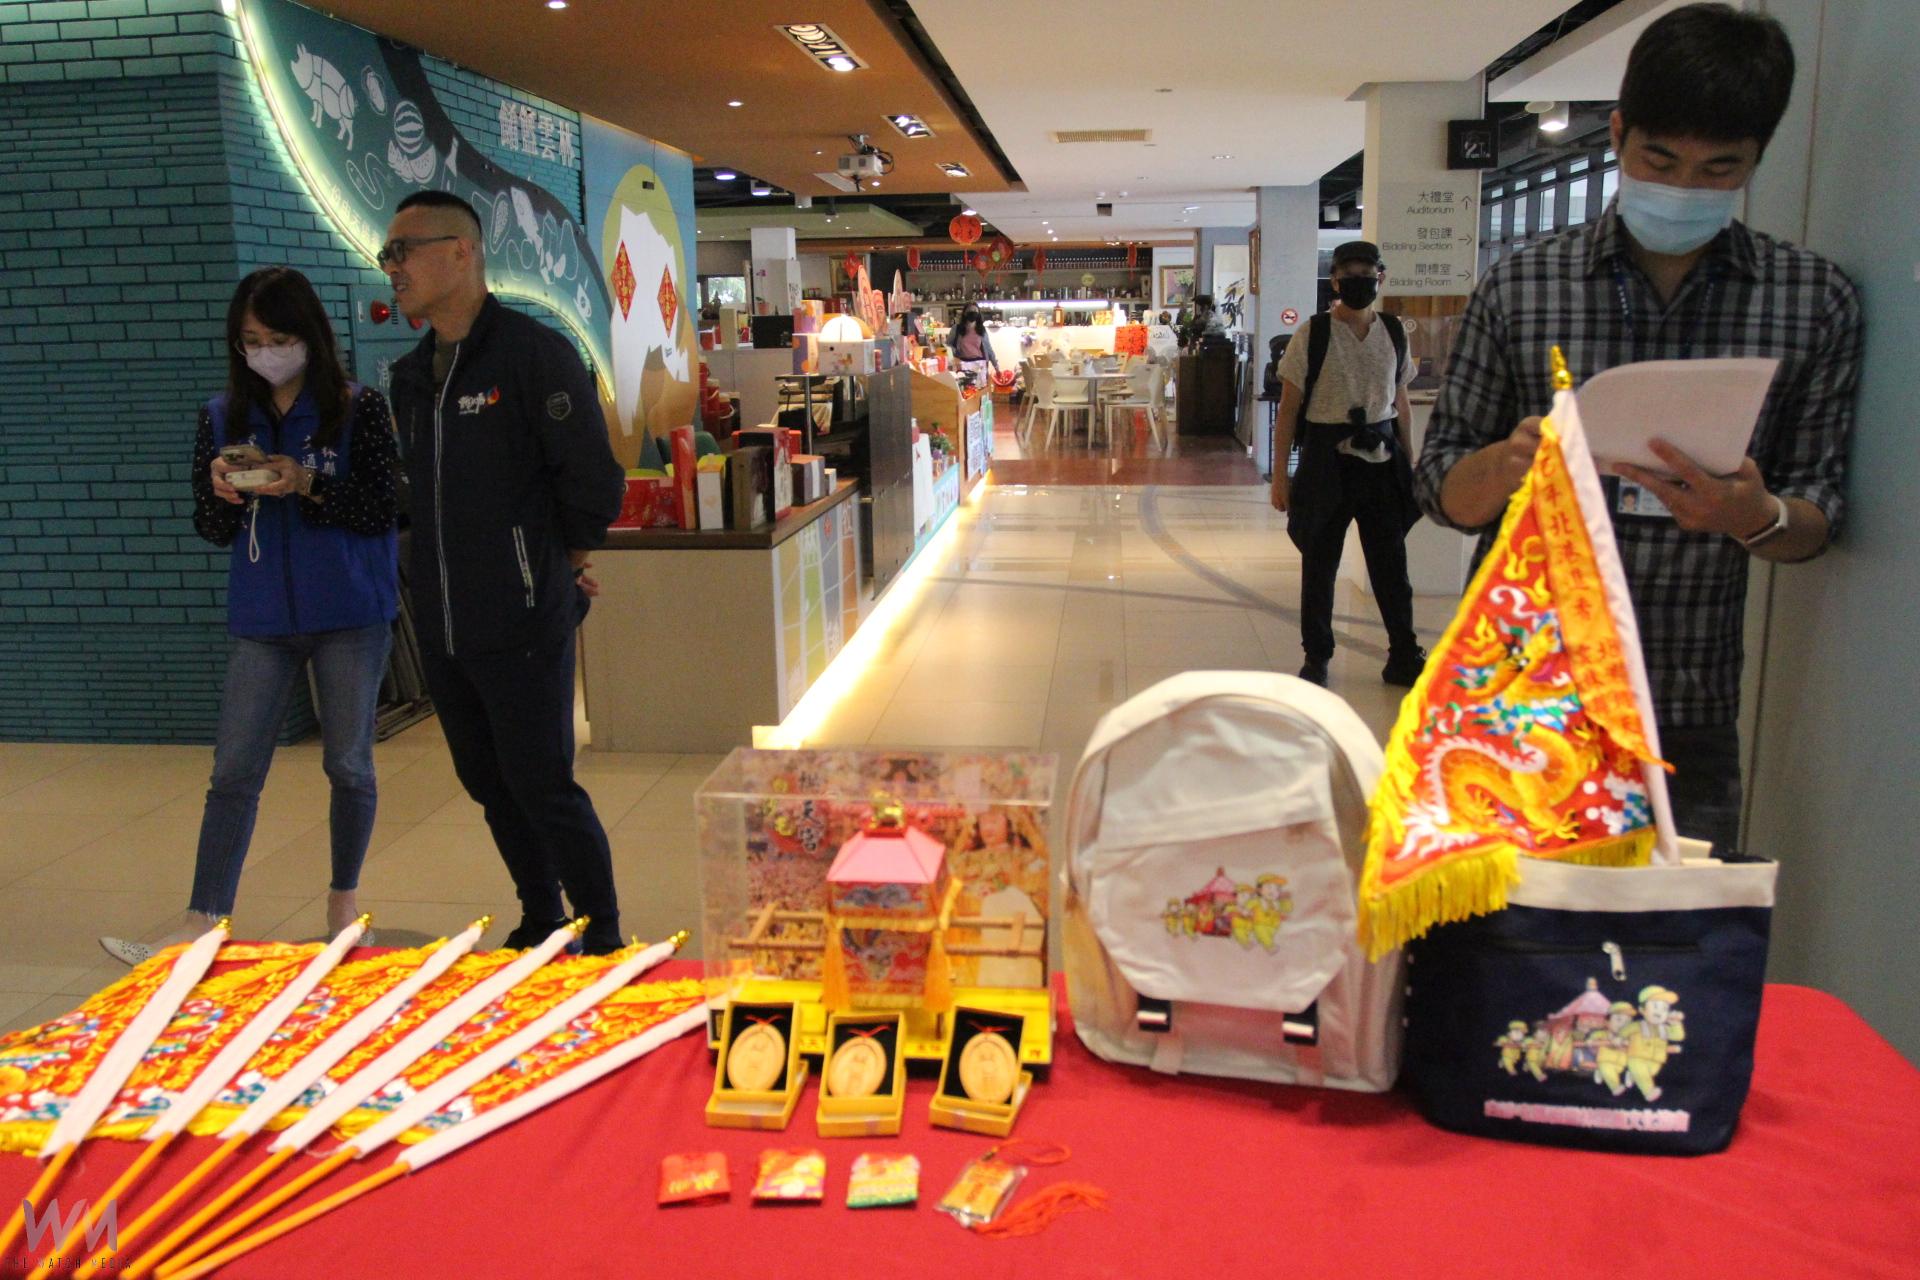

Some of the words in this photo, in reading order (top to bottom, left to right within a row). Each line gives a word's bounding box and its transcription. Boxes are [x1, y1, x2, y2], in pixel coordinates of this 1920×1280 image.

[1418, 191, 1455, 203] 大禮堂
[1407, 206, 1455, 215] Auditorium
[1382, 242, 1417, 252] Bidding
[1419, 242, 1453, 251] Section
[1415, 263, 1452, 276] 開標室
[1389, 278, 1423, 288] Bidding
[1425, 278, 1452, 287] Room
